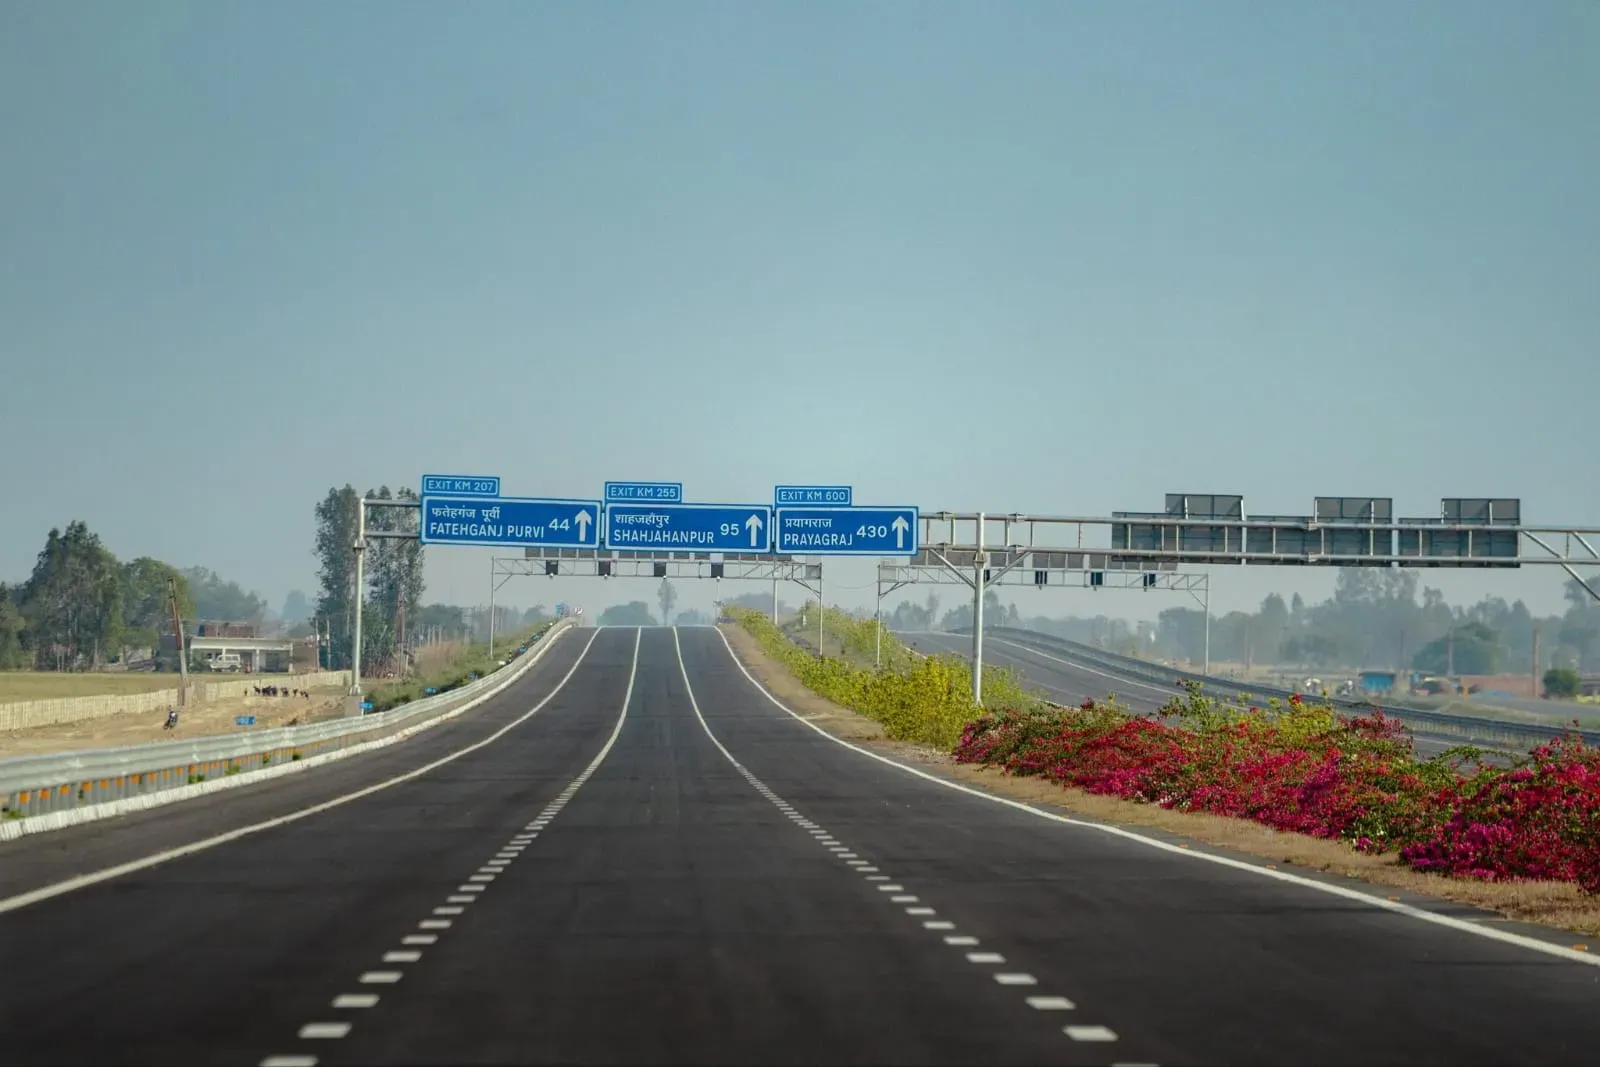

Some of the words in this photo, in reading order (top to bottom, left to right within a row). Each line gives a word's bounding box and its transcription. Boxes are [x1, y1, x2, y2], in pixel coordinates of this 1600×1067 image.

[428, 480, 452, 490] EXIT
[455, 481, 471, 491] KM
[474, 481, 494, 492] 207
[611, 487, 634, 497] EXIT
[637, 488, 653, 497] KM
[657, 488, 676, 498] 255
[781, 491, 804, 500] EXIT
[807, 491, 822, 500] KM
[826, 491, 846, 501] 600
[431, 505, 476, 519] फतेहगंज
[482, 506, 500, 522] पूर्वी
[548, 518, 570, 532] 44
[720, 523, 740, 536] 95
[784, 518, 833, 528] प्रयागराज
[430, 522, 503, 537] FATEHGANJ
[507, 526, 545, 539] PURVI
[613, 529, 714, 544] SHAHJAHANPUR
[856, 525, 888, 538] 430
[784, 533, 853, 546] PRAYAGRAJ
